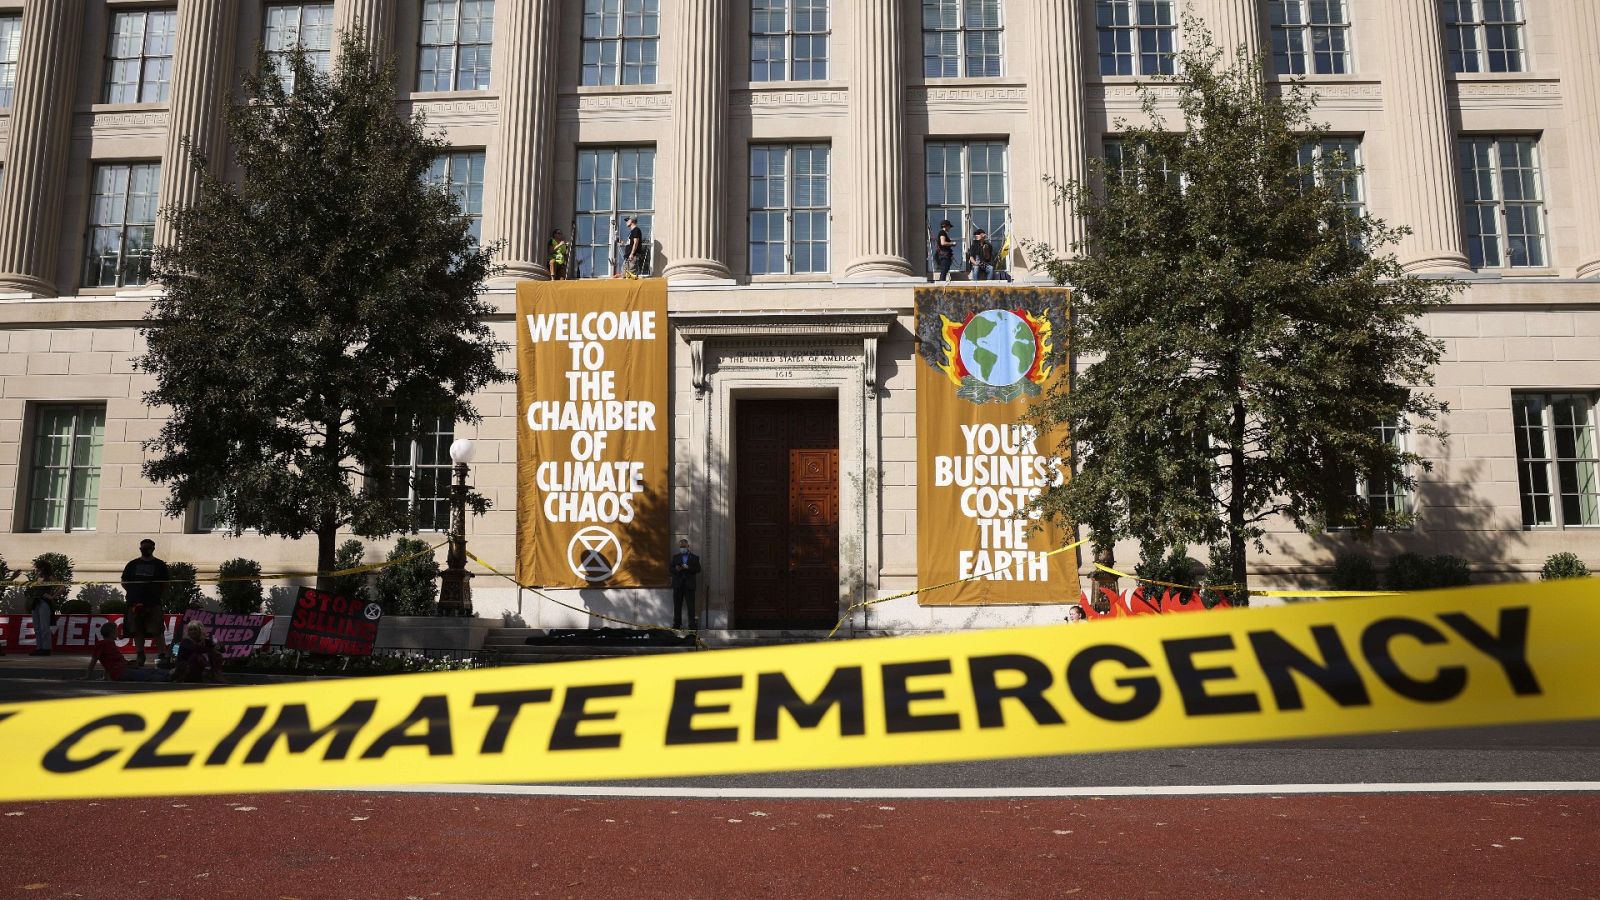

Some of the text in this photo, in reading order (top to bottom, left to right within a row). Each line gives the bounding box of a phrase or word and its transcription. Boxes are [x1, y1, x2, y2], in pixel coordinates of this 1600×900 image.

[526, 310, 656, 342] WELCOME
[568, 341, 605, 371] TO
[729, 356, 744, 364] THE
[779, 355, 805, 363] STATES
[565, 370, 616, 401] THE
[527, 400, 657, 431] CHAMBER
[570, 430, 607, 462] OF
[960, 423, 1038, 455] YOUR
[536, 461, 644, 493] CLIMATE
[934, 455, 1064, 487] BUSINESS
[543, 492, 635, 524] CHAOS
[960, 487, 1043, 519] COSTS
[977, 518, 1028, 550] THE
[959, 550, 1048, 582] EARTH
[298, 590, 364, 616] STOP
[214, 613, 265, 628] WEALTH
[214, 627, 255, 642] NEED
[41, 605, 1544, 774] CLIMATE EMERGENCY
